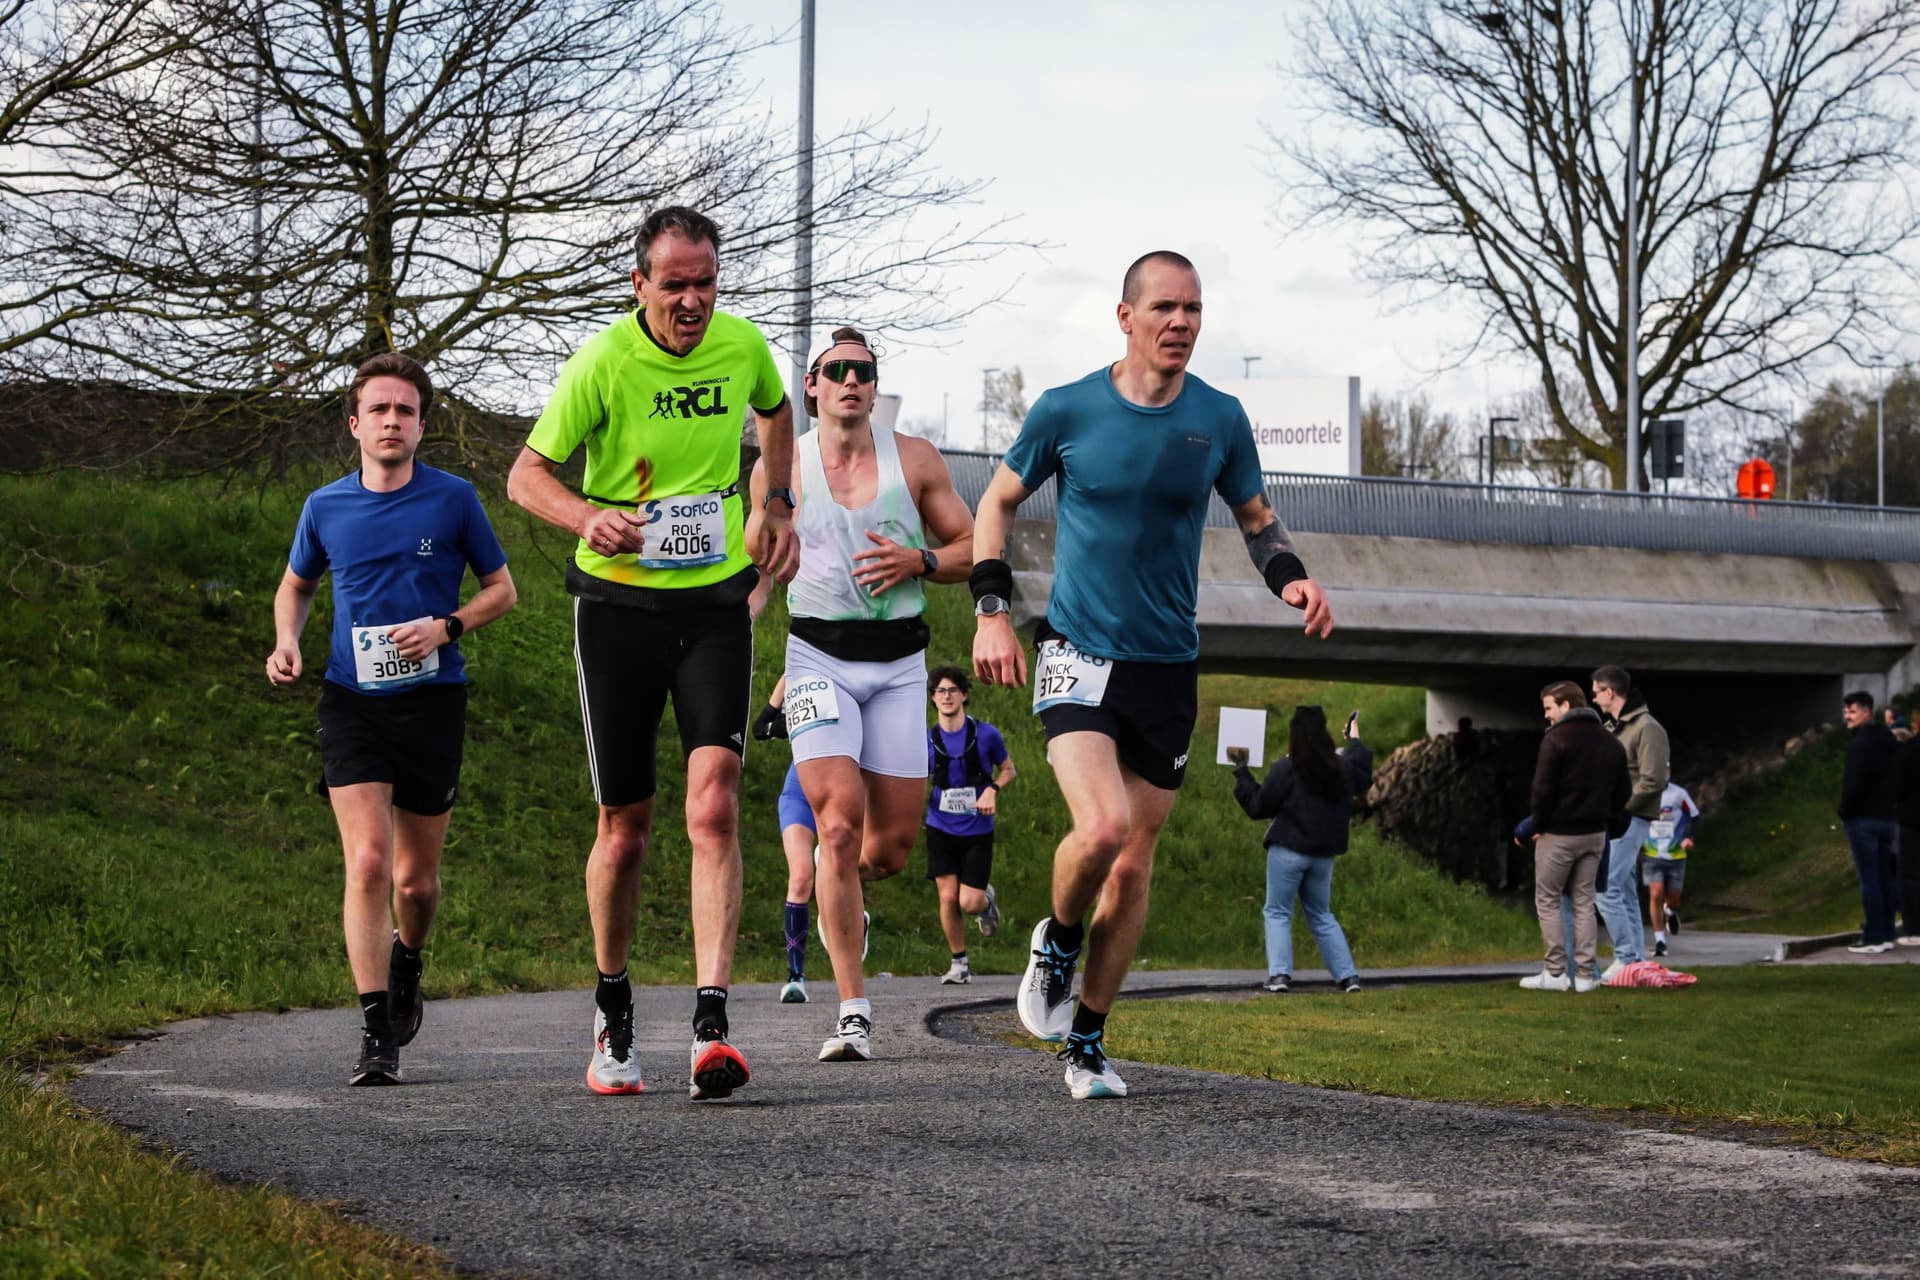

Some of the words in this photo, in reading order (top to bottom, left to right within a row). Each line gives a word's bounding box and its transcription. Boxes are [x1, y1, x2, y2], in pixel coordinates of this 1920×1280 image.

[672, 386, 728, 418] RCL
[670, 501, 719, 518] SOFICO
[671, 523, 702, 536] ROLF
[659, 534, 711, 555] 4006
[384, 648, 408, 660] TIJ
[1046, 646, 1106, 667] SOFICO
[1046, 663, 1073, 676] NICK
[786, 681, 829, 703] SOFICO
[1040, 675, 1079, 697] 3127
[787, 696, 814, 714] MON
